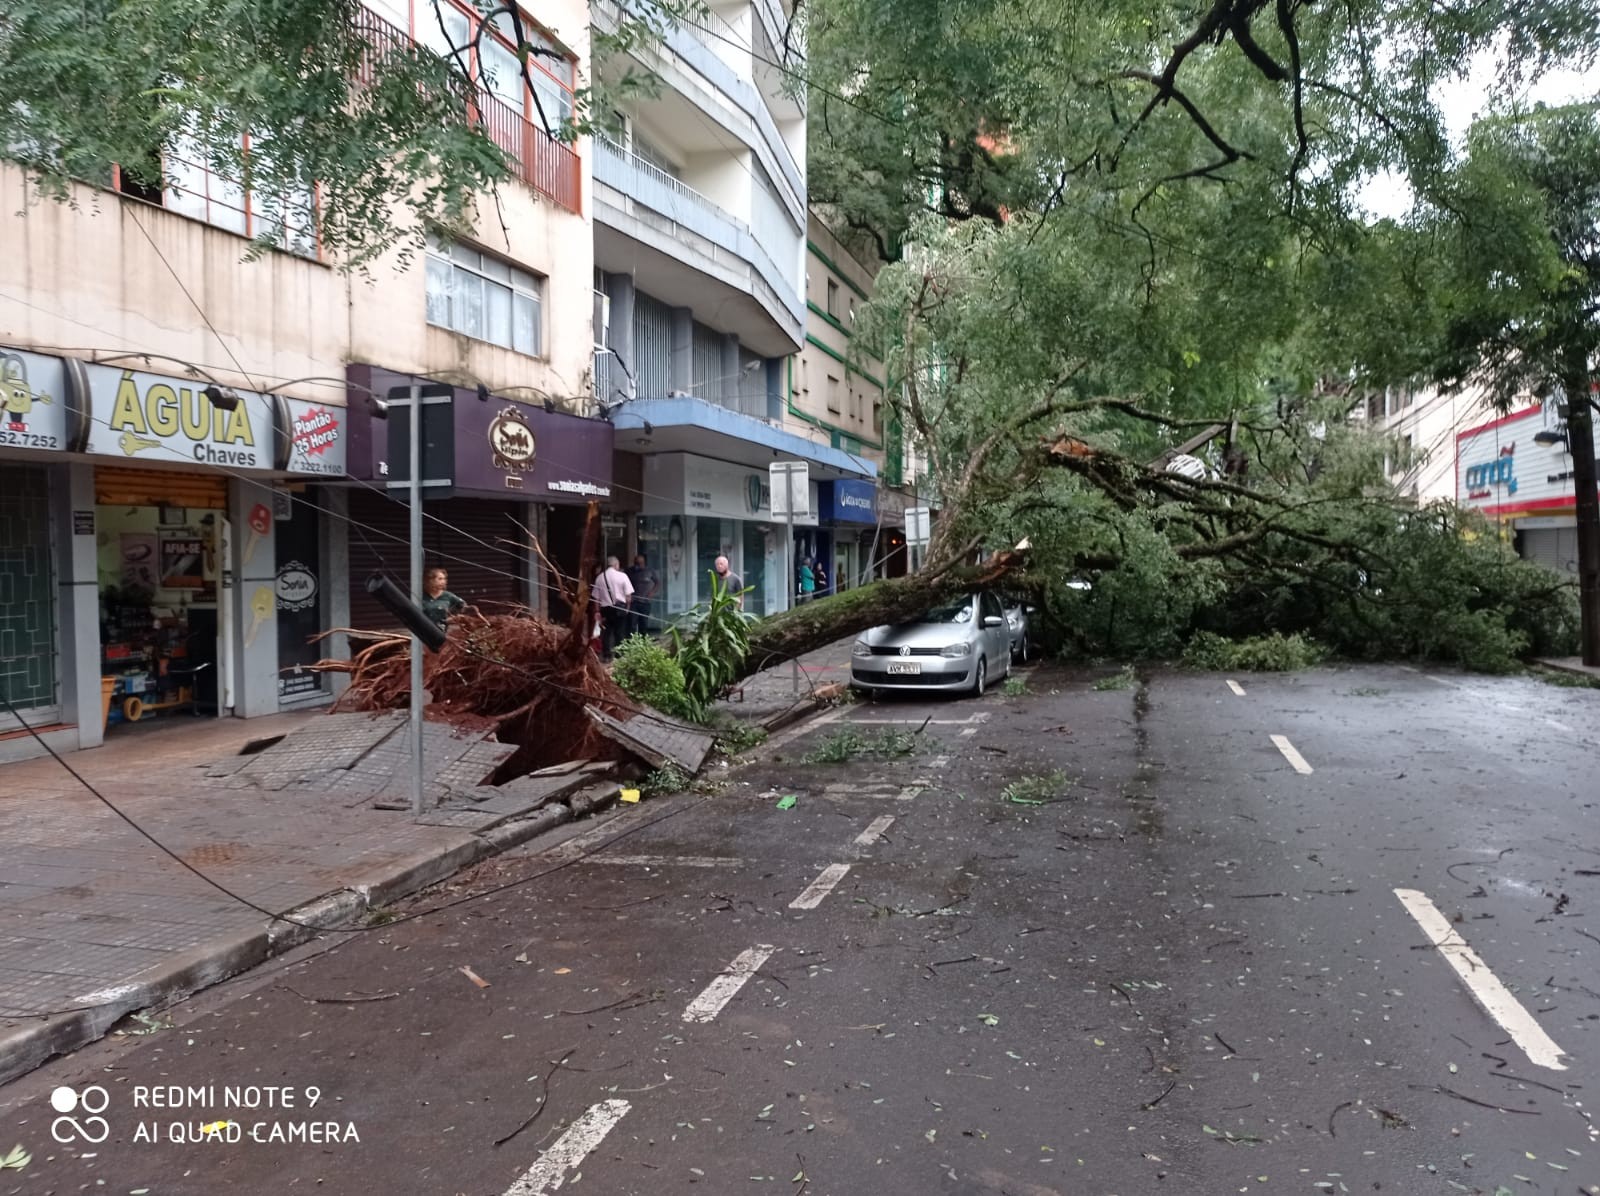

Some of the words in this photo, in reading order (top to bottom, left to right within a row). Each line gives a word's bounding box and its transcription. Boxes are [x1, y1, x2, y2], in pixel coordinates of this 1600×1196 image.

[110, 370, 255, 446] ÁGUIA
[295, 412, 331, 436] Plantão
[309, 429, 338, 449] Horas
[193, 443, 256, 466] Chaves
